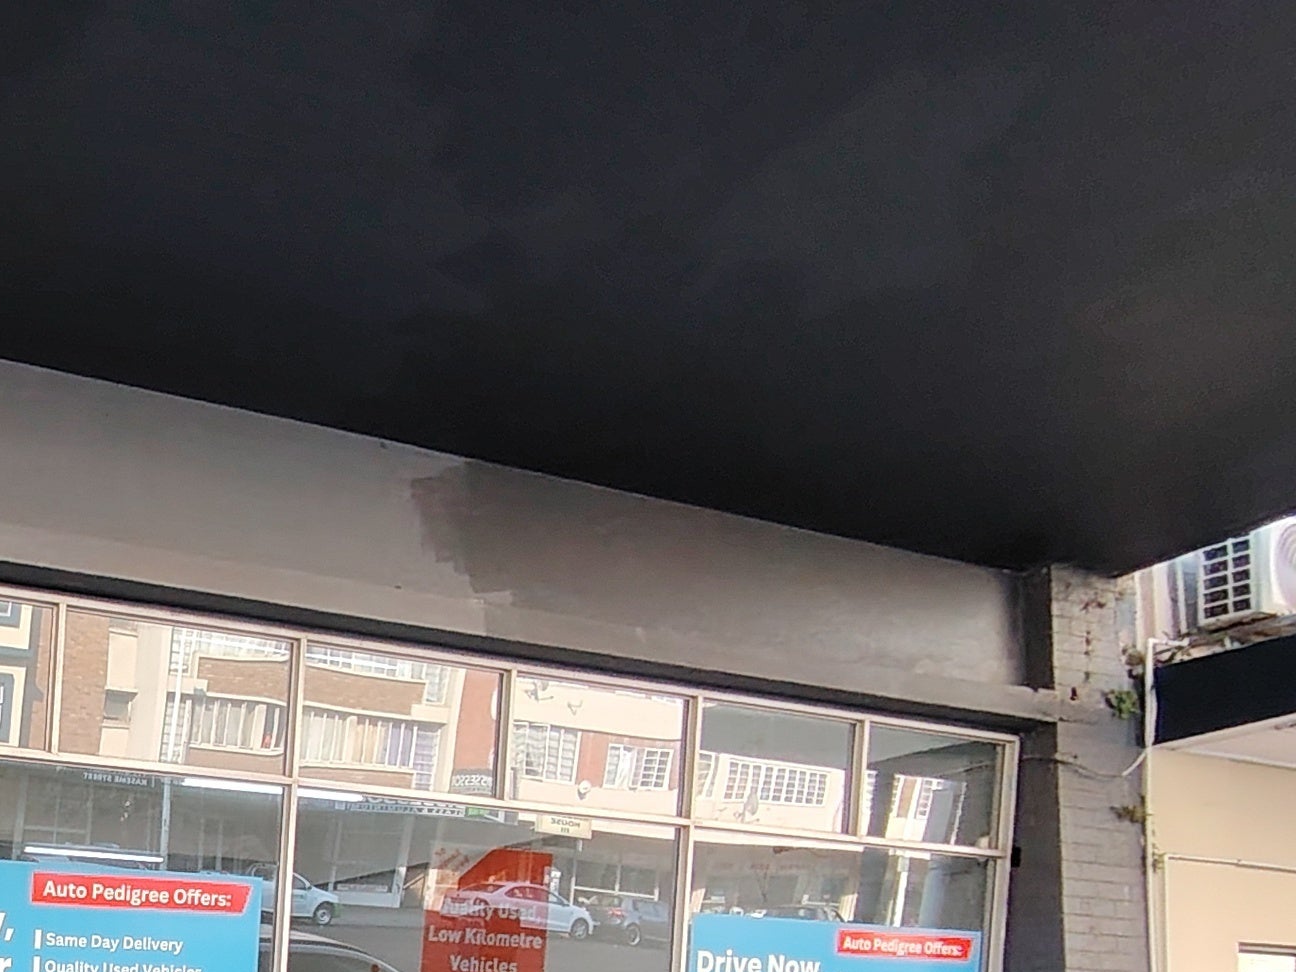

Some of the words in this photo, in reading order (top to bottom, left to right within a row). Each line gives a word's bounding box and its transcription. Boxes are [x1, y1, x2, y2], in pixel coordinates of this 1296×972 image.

[42, 880, 87, 899] Auto
[92, 884, 169, 905] Pedigree
[174, 888, 232, 907] Offers:
[46, 933, 87, 948] Same
[91, 935, 119, 952] Day
[123, 936, 183, 955] Delivery
[428, 925, 460, 944] Low
[464, 928, 543, 949] Kilometre
[843, 936, 871, 950] Auto
[873, 939, 922, 956] Pedigree
[924, 942, 962, 956] Offers:
